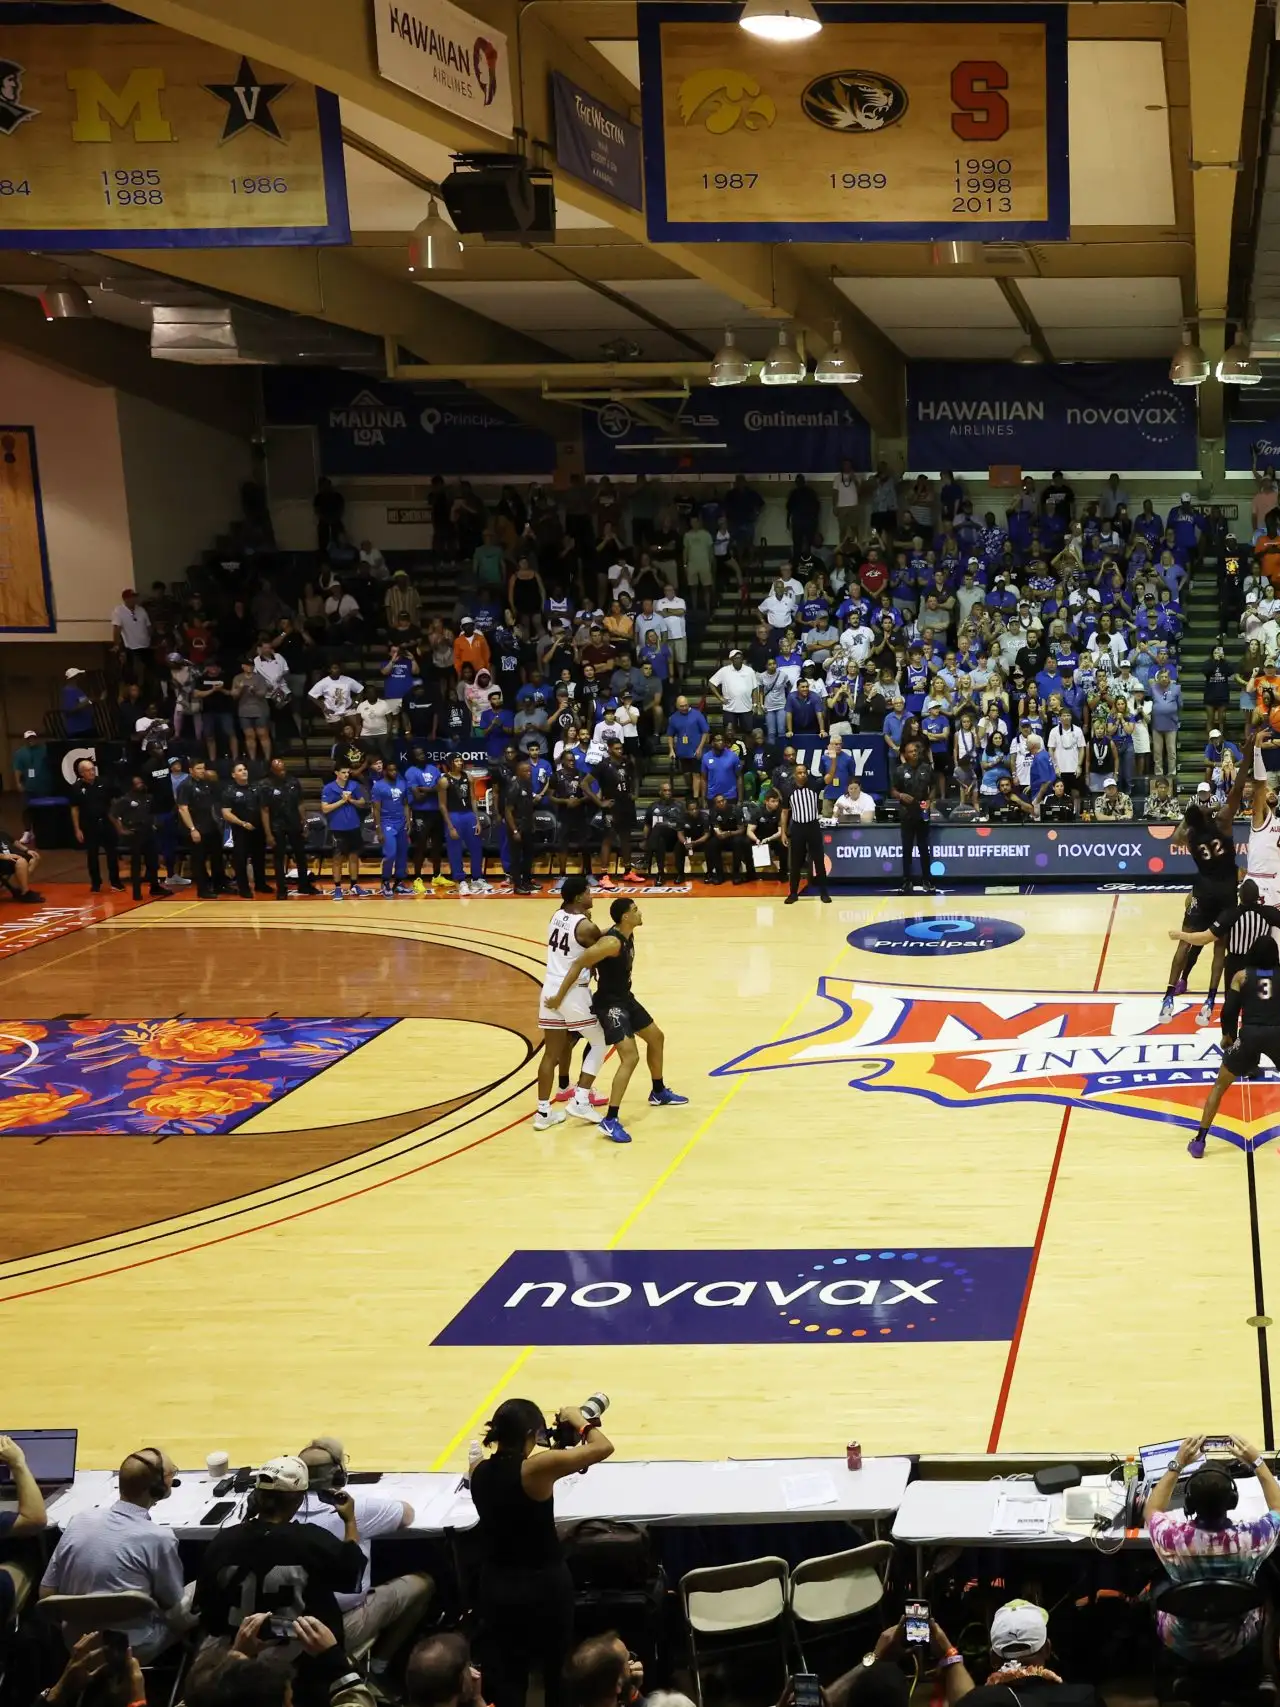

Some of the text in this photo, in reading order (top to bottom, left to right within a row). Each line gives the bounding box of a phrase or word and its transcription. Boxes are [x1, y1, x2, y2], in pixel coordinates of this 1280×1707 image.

[389, 6, 471, 77] HAWAIIAN
[432, 66, 473, 99] AIRLINES
[591, 106, 626, 147] WESTIN
[953, 158, 1012, 175] 1990
[101, 169, 161, 187] 1985
[230, 177, 289, 195] 1986
[701, 172, 759, 190] 1987
[829, 172, 887, 190] 1989
[953, 178, 1012, 194] 1998
[0, 180, 32, 197] 84
[103, 189, 164, 206] 1988
[951, 197, 1013, 214] 2013
[329, 410, 408, 429] MAUNA
[918, 401, 1044, 421] HAWAIIAN
[1066, 407, 1177, 425] novavax
[443, 412, 506, 429] Princip
[744, 410, 839, 431] Continental
[353, 429, 386, 446] LOA
[950, 424, 1014, 436] AIRLINES
[796, 748, 874, 777] LUY
[836, 846, 872, 858] COVID
[932, 846, 965, 858] BUILT
[967, 845, 1031, 858] DIFFERENT
[1057, 842, 1142, 857] novavax
[1198, 838, 1225, 861] 32
[1096, 882, 1194, 892] Tomm
[548, 928, 571, 957] 44
[874, 938, 991, 949] Principal
[1256, 978, 1273, 1000] 3
[502, 1278, 945, 1309] novavax
